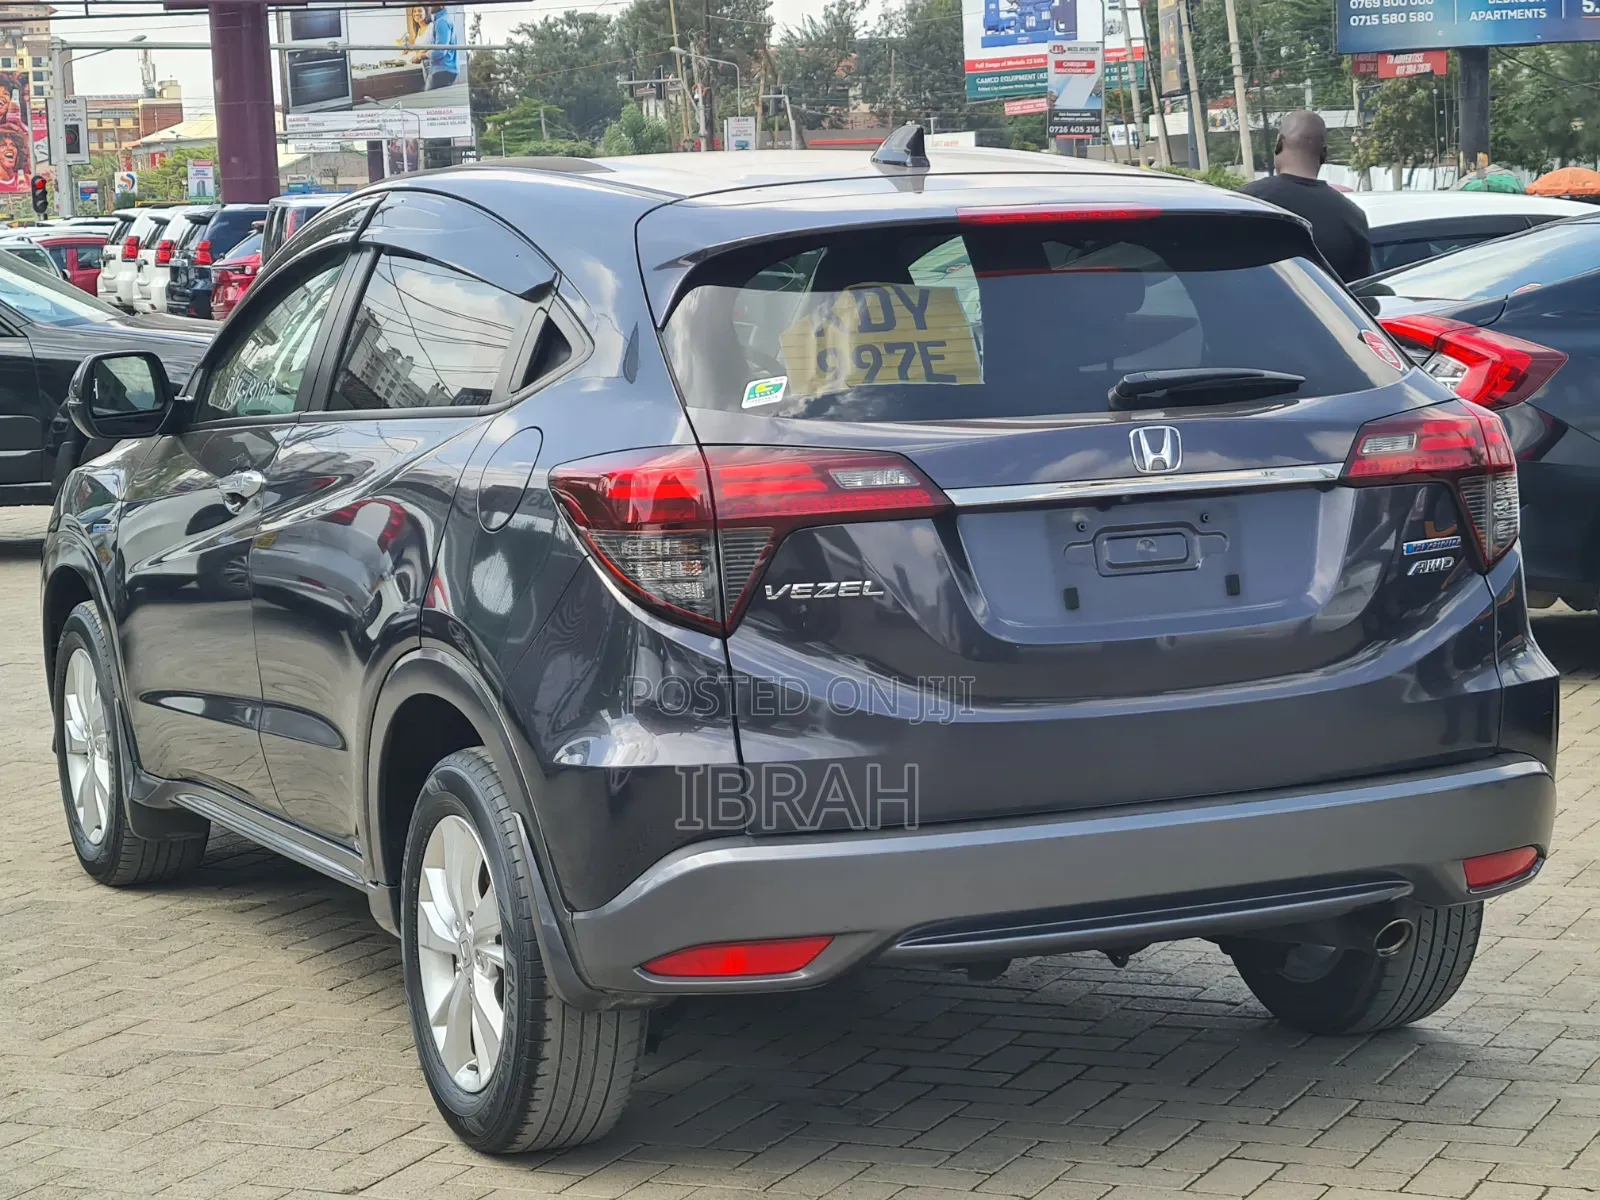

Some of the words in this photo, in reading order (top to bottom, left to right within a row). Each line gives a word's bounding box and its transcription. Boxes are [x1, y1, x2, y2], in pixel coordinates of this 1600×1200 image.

[1350, 0, 1380, 9] 0769
[1350, 14, 1379, 26] 0715
[1381, 13, 1406, 25] 580
[1409, 11, 1434, 23] 580
[1469, 8, 1547, 21] APARTMENTS
[976, 76, 999, 84] CAMCO
[1000, 73, 1036, 83] EQUIPMENT
[1049, 125, 1068, 133] 0726
[1069, 125, 1085, 133] 405
[1086, 125, 1100, 133] 236
[816, 284, 932, 338] DY
[1407, 556, 1455, 576] AWD
[764, 580, 884, 600] VEZEL
